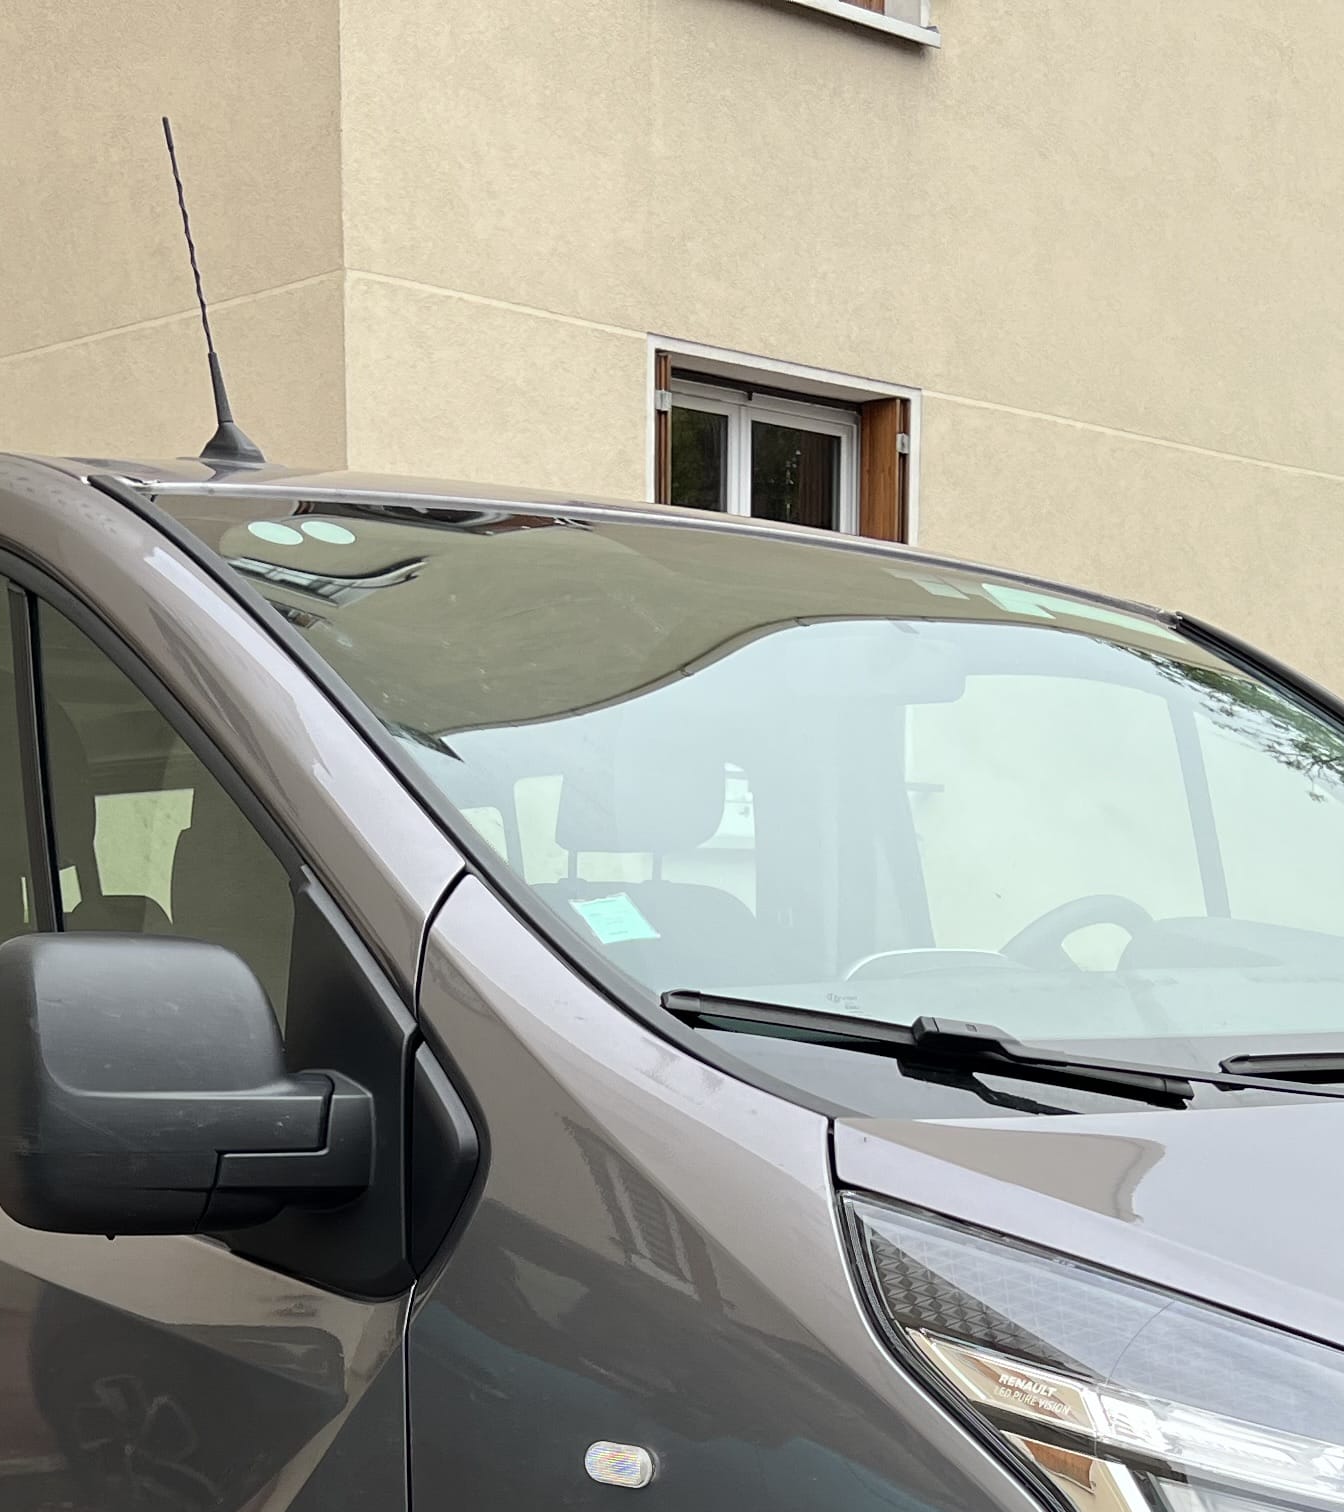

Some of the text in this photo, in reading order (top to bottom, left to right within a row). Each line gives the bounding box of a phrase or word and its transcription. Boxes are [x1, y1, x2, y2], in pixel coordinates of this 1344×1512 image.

[998, 1374, 1057, 1397] RENAULT
[1013, 1390, 1036, 1406] PURE
[1038, 1398, 1071, 1415] VISION
